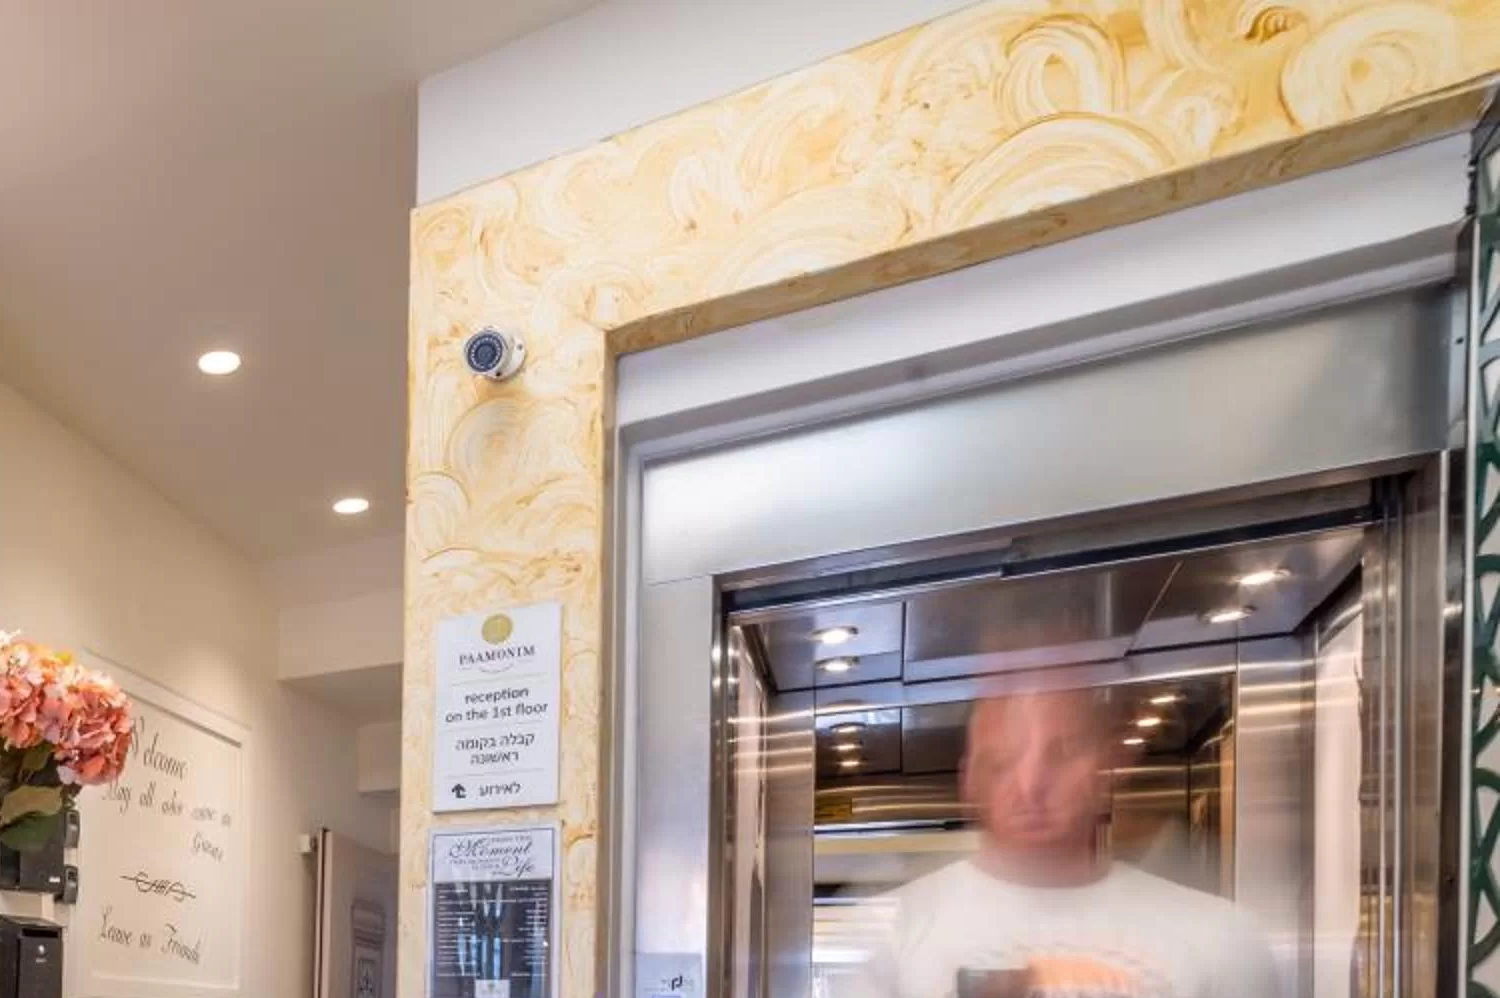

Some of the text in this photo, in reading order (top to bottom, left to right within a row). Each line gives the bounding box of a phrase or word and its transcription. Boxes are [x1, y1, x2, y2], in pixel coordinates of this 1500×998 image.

[458, 644, 536, 666] PAAMONIM
[464, 687, 529, 704] reception
[445, 701, 548, 723] on the 1st floor
[455, 732, 535, 751] קבלה בקומה
[469, 751, 519, 765] ראשונה
[479, 781, 521, 796] לאירוע
